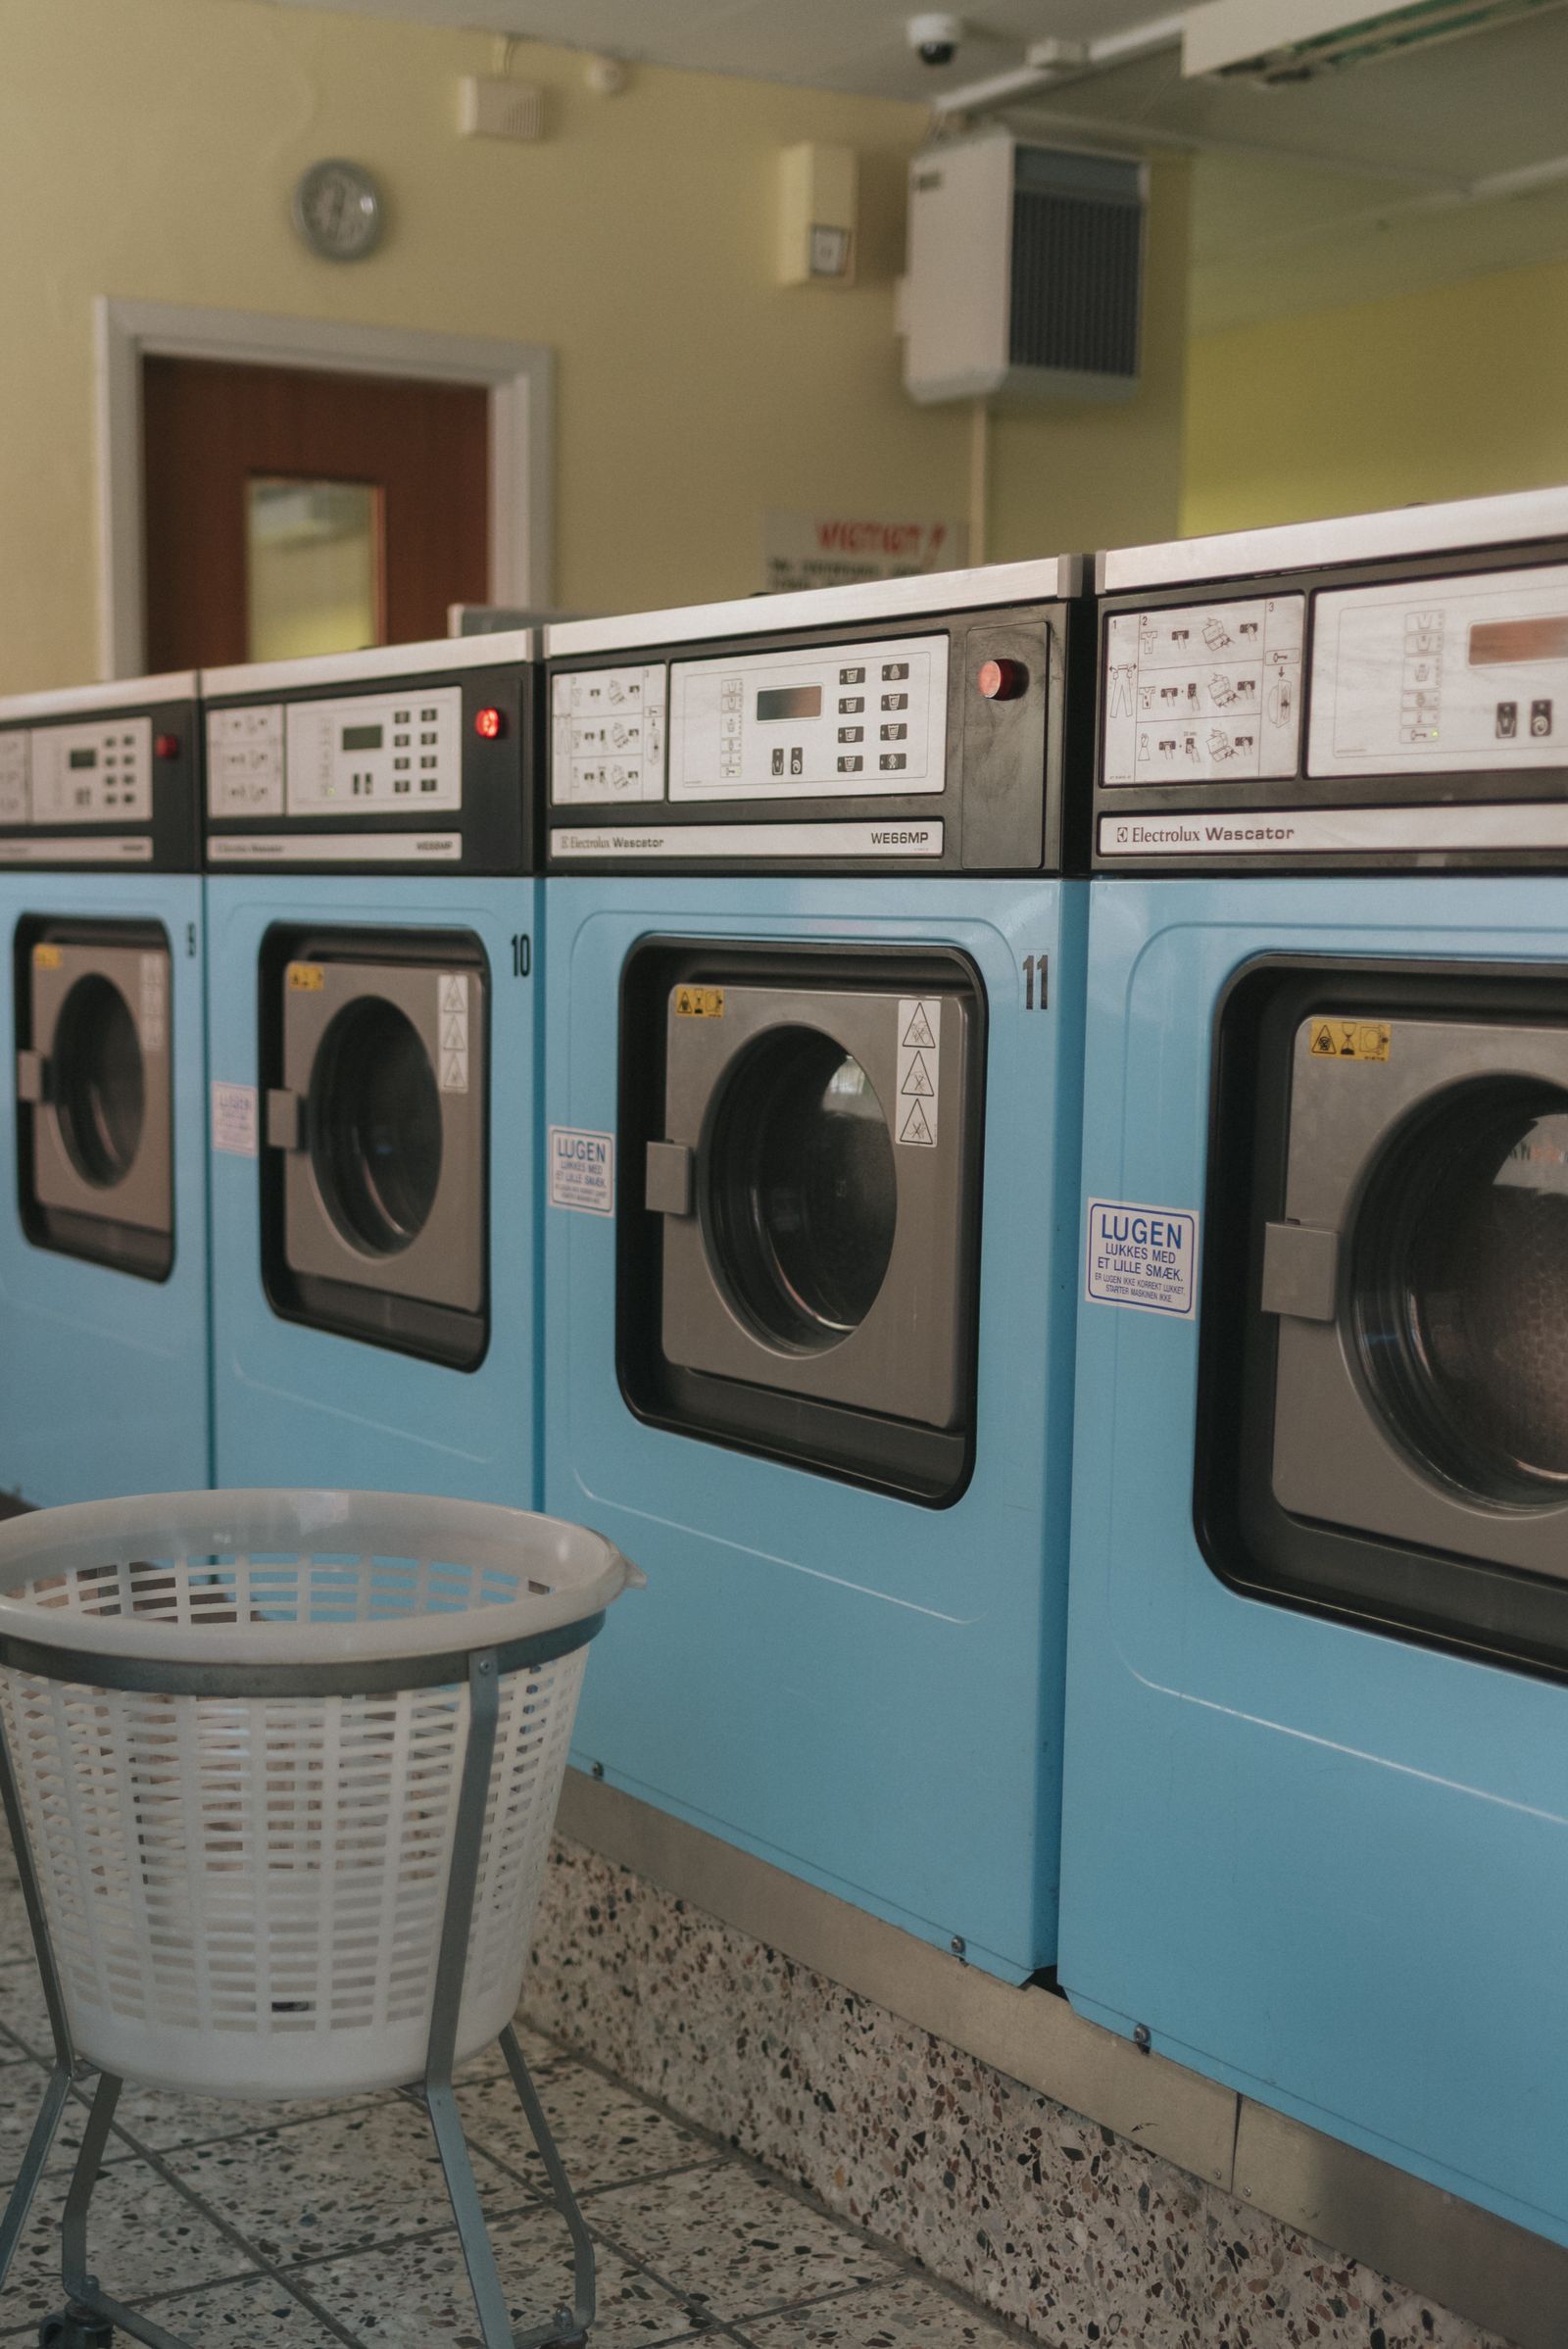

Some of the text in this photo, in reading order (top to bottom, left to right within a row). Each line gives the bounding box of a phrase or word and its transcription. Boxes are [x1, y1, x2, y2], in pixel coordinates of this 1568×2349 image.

[1112, 618, 1117, 629] 1
[1142, 615, 1148, 626] 2
[570, 836, 664, 849] Electrolux Wascator
[870, 832, 929, 844] WE66MP
[1132, 826, 1295, 843] Electrolux Wascator
[511, 933, 530, 977] 10
[1022, 954, 1049, 1009] 11
[558, 1138, 606, 1163] LUGEN
[1102, 1214, 1182, 1249] LUGEN
[1105, 1243, 1176, 1264] LUKKES MED
[1098, 1256, 1184, 1282] ET LILLE SMÆK.
[1103, 1274, 1121, 1284] LUGEN
[1123, 1277, 1136, 1287] IKKE
